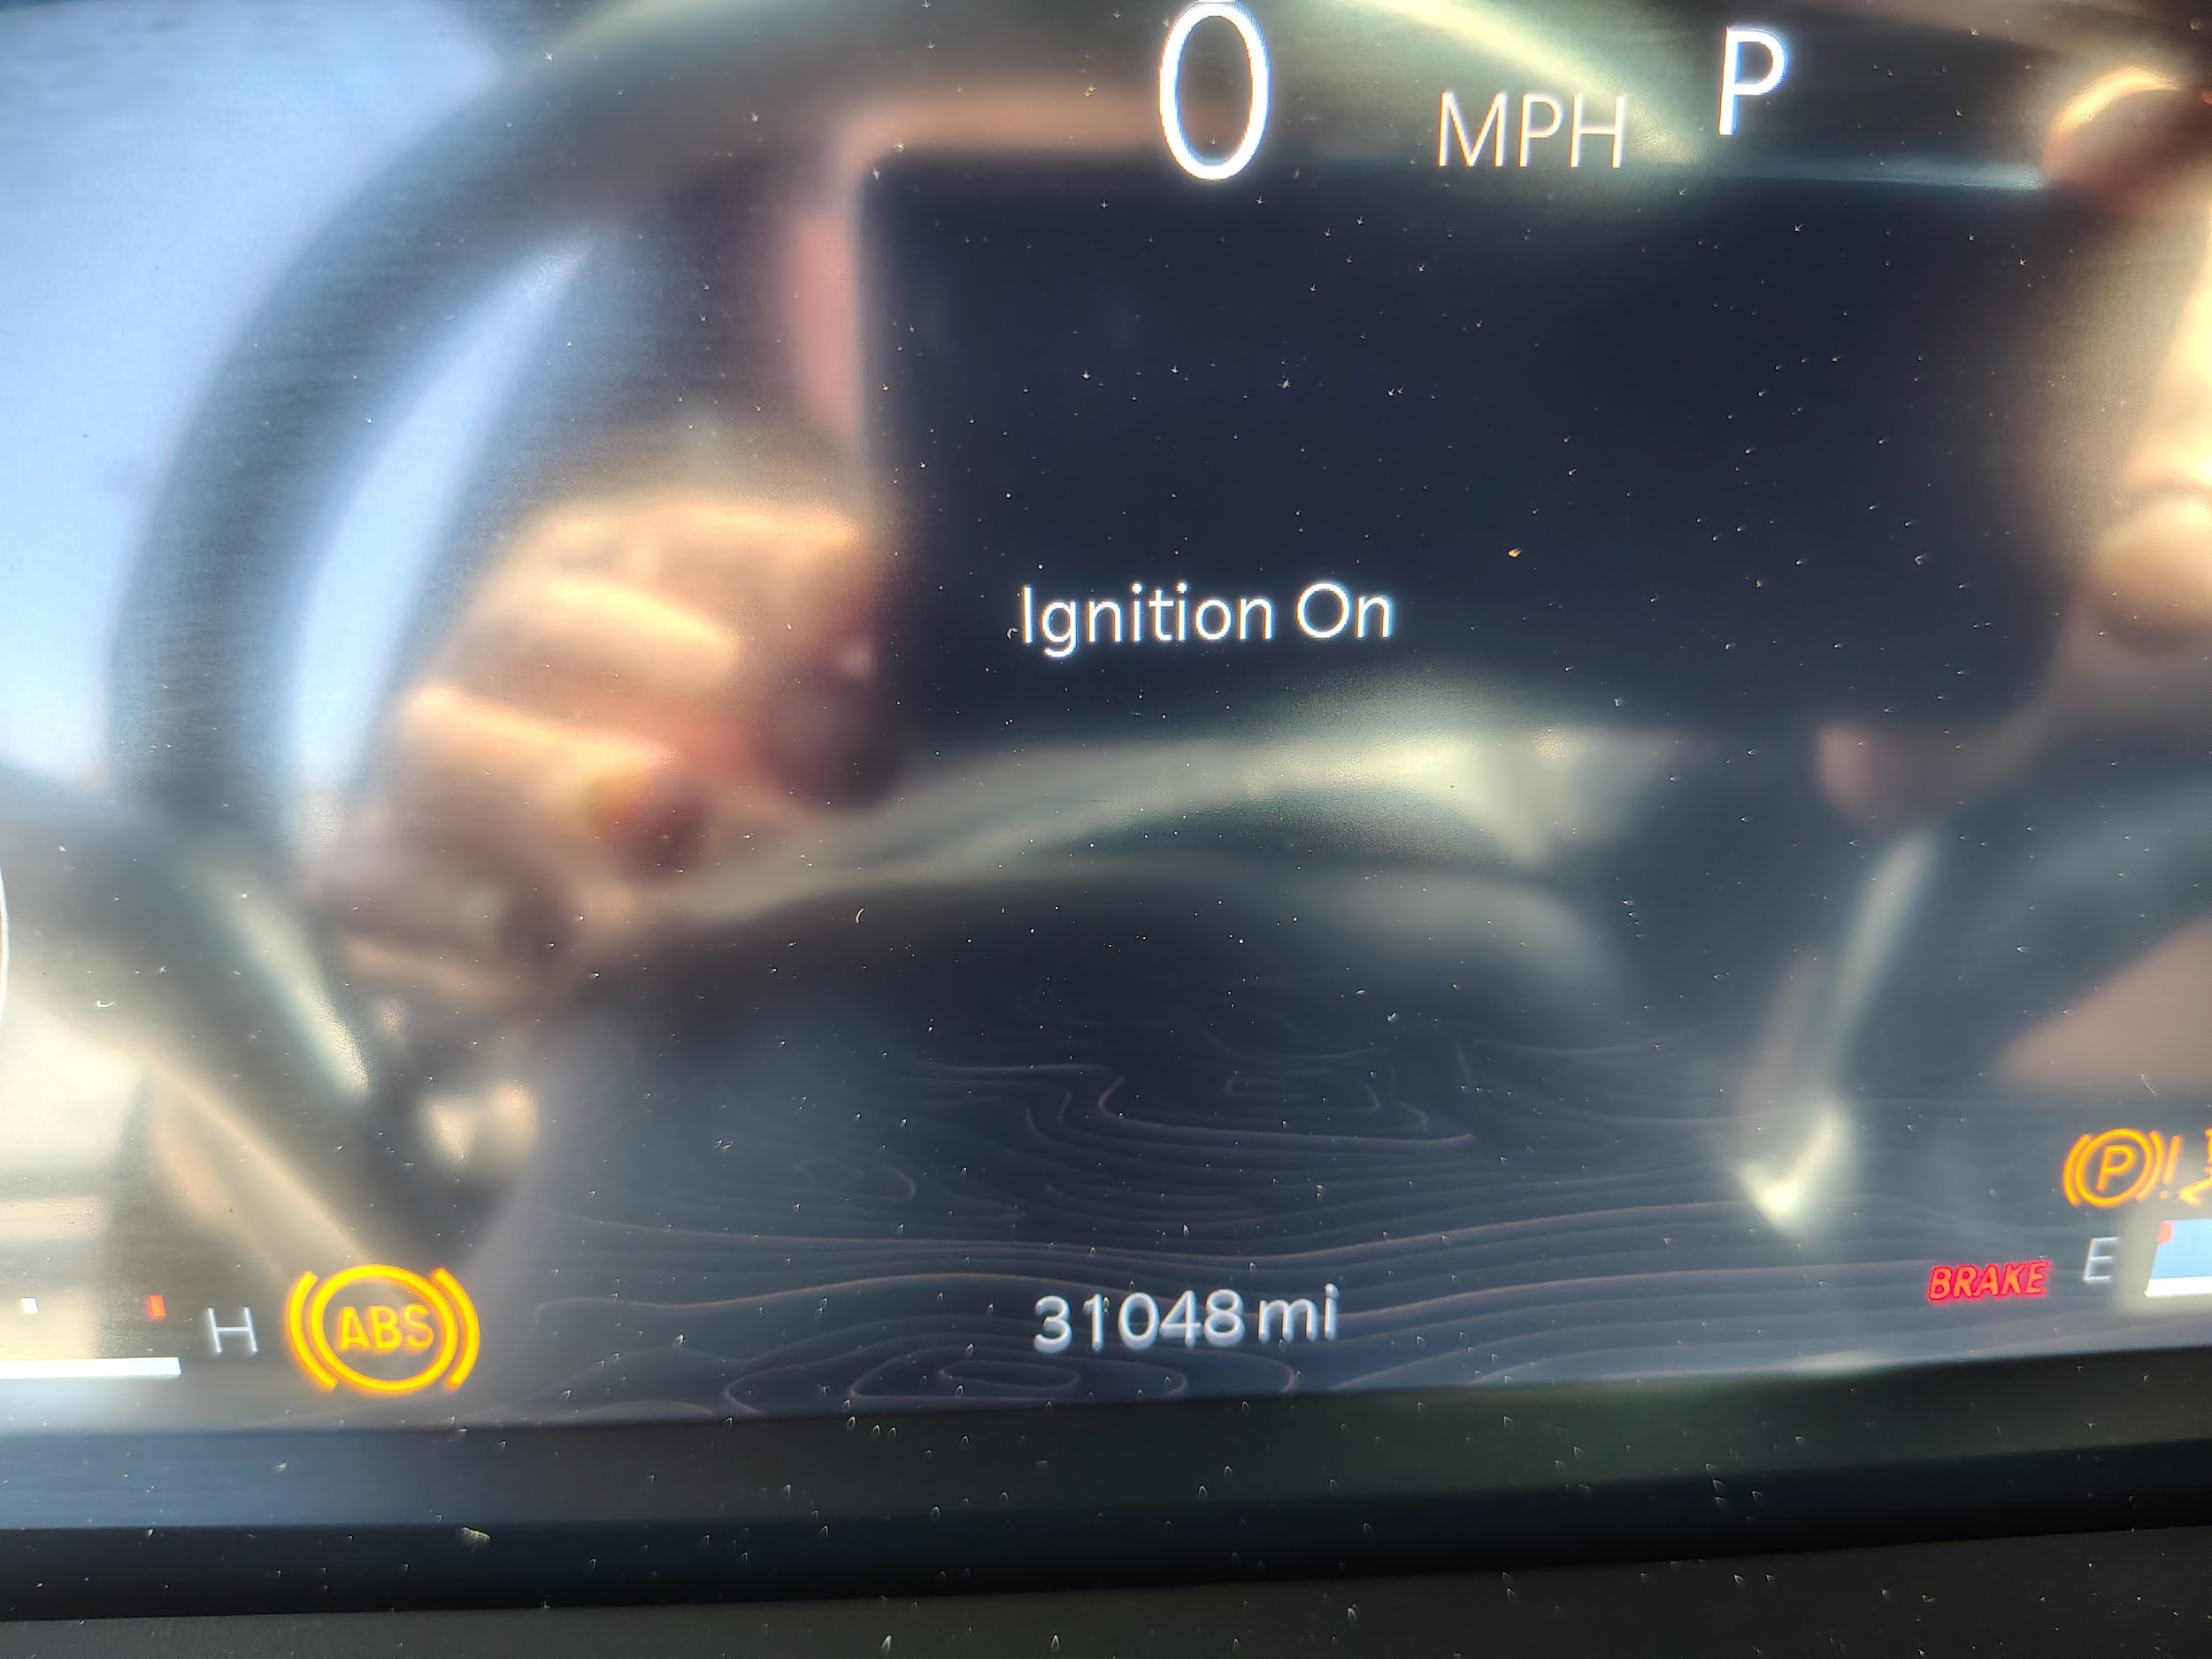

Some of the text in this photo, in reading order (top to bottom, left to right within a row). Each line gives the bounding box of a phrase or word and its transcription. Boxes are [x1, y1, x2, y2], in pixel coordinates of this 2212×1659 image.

[1158, 1, 1271, 180] 0
[1717, 27, 1789, 136] P
[1436, 91, 1627, 169] MPH
[1022, 581, 1393, 657] Ignition On
[1927, 1259, 2052, 1303] BRAKE
[2083, 1236, 2120, 1283] E
[206, 1307, 258, 1354] H
[339, 1302, 435, 1351] ABS
[1033, 1283, 1340, 1355] 31048 mi
